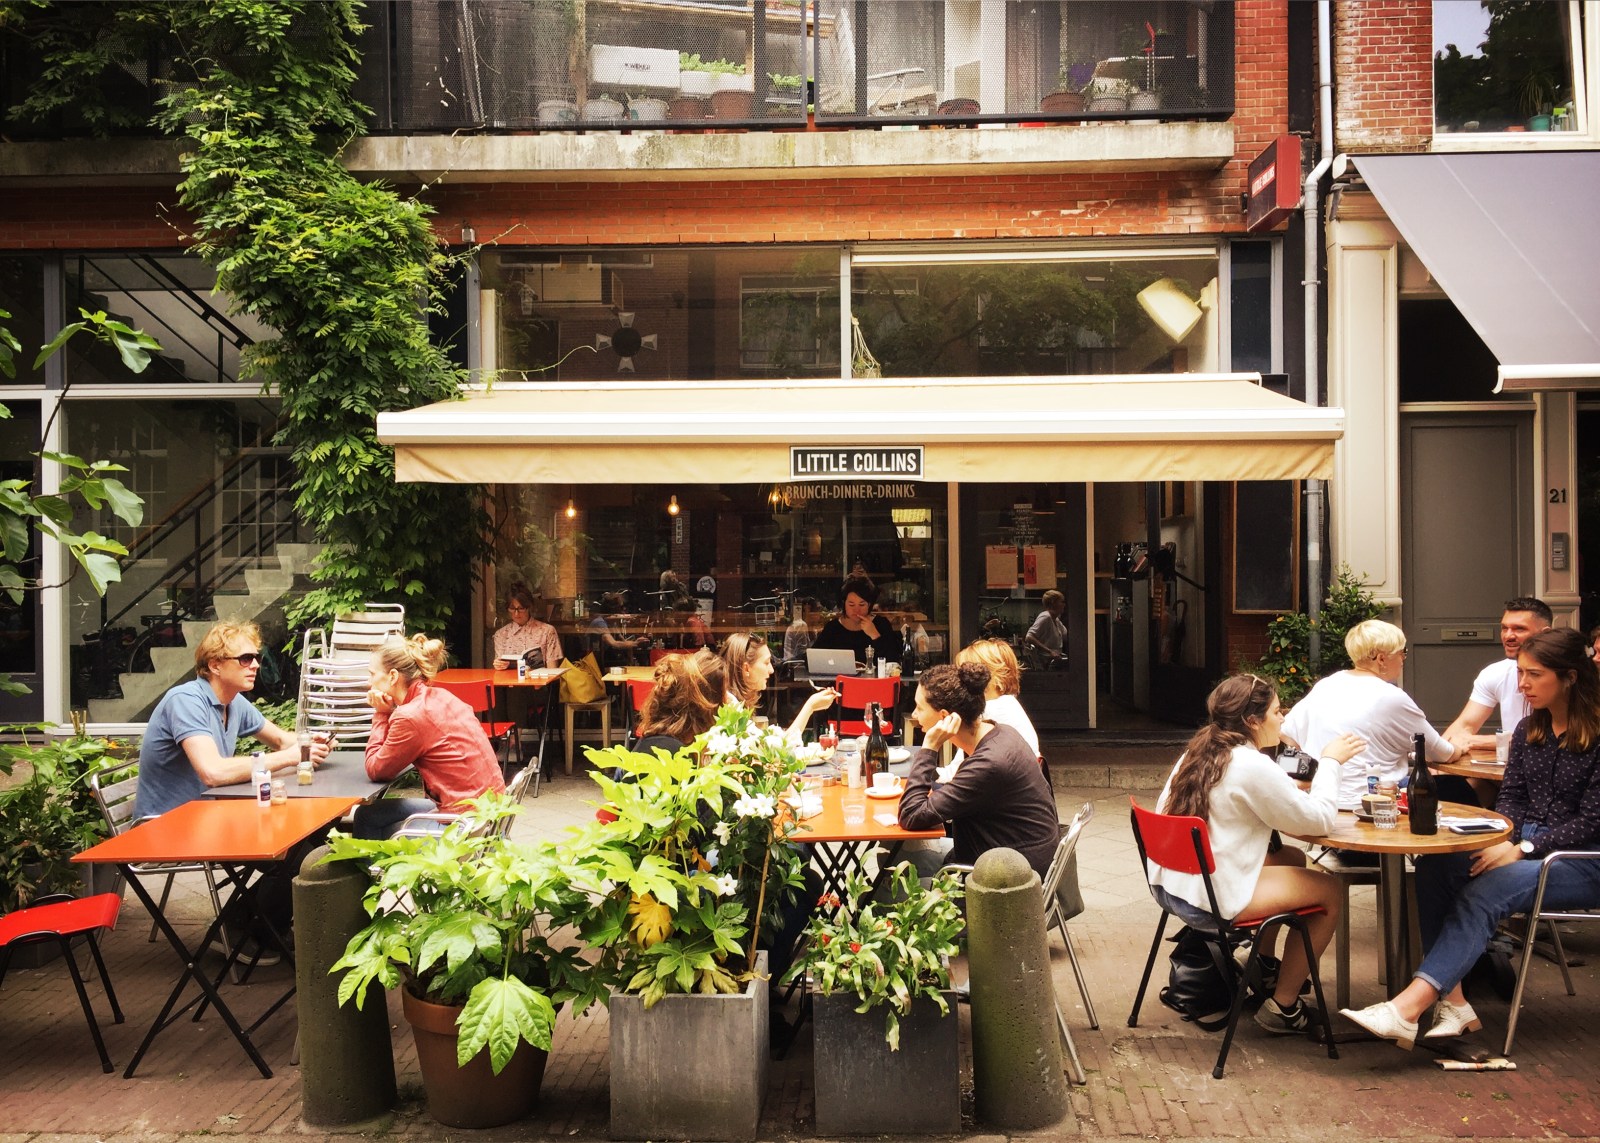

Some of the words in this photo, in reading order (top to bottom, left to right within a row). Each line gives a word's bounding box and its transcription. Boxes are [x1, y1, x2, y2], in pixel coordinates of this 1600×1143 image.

[797, 453, 848, 473] LITTLE
[853, 452, 917, 473] COLLINS
[785, 483, 916, 499] BRUNCH-DINNER-DRINKS
[1549, 488, 1567, 504] 21
